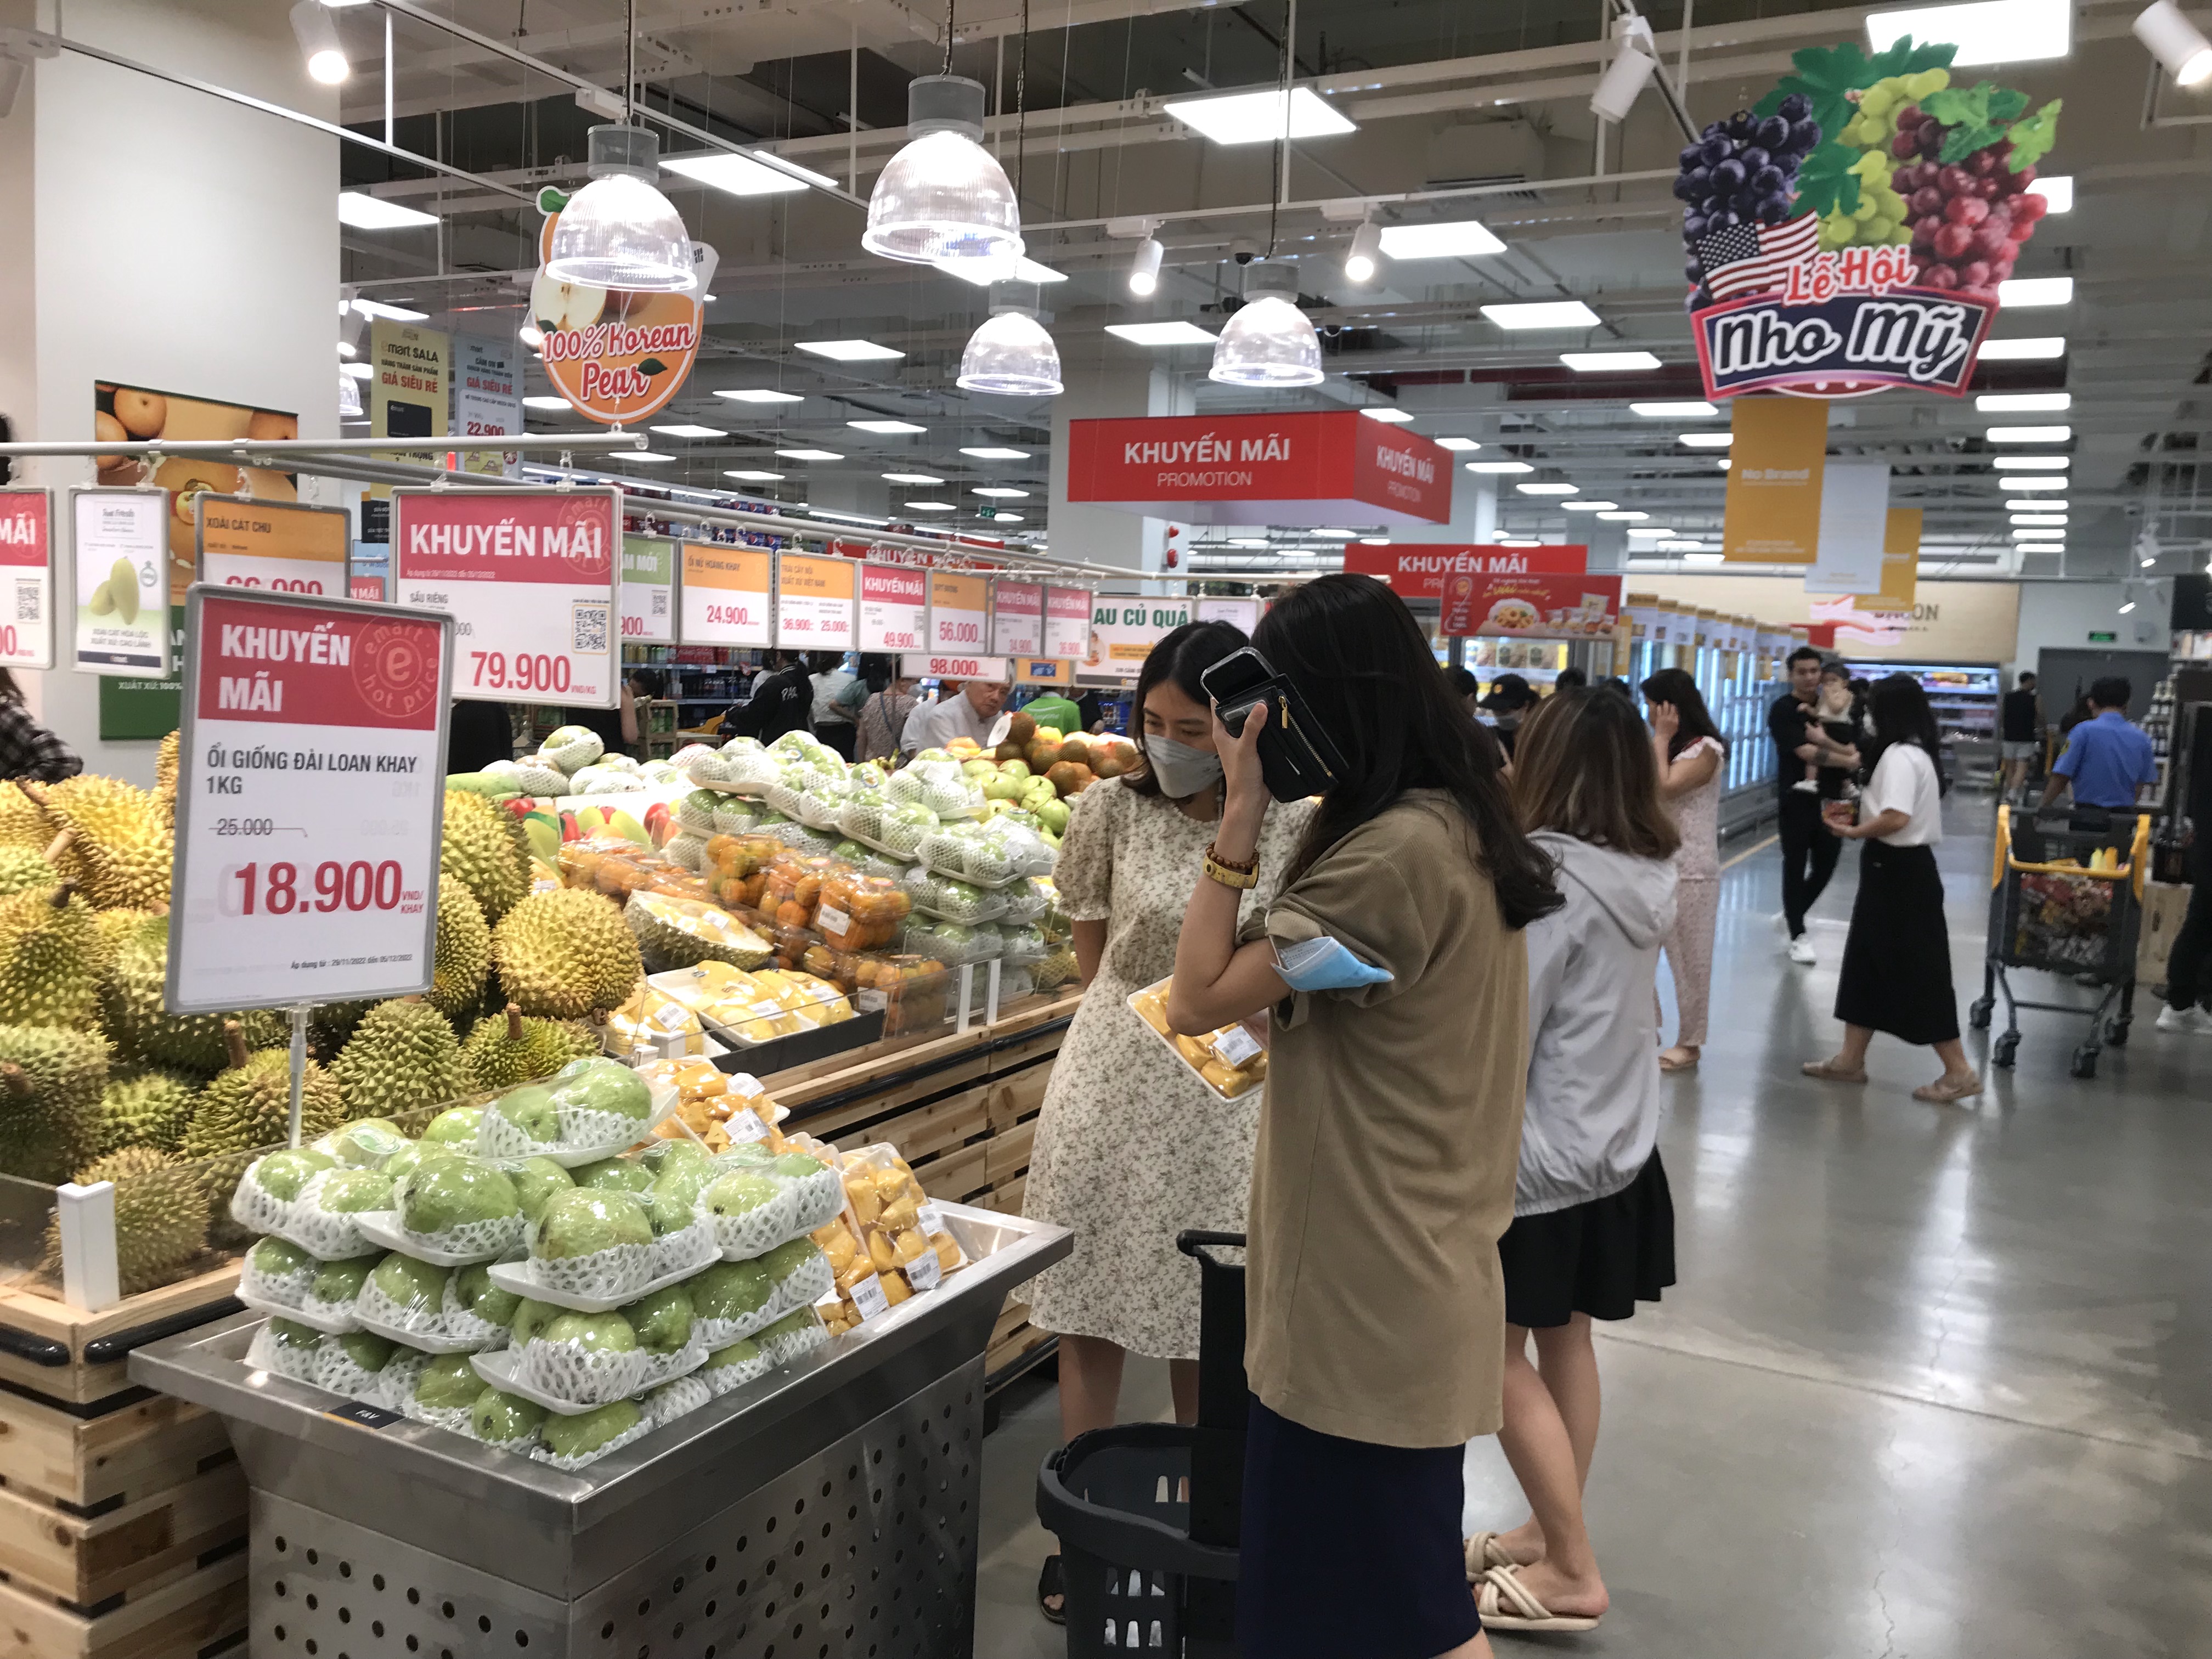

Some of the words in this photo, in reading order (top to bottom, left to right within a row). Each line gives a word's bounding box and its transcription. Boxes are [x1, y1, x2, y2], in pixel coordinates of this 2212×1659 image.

[1783, 253, 1838, 307] Lễ
[1839, 245, 1918, 295] Hội
[413, 347, 438, 362] SALA
[544, 323, 607, 362] 100%
[607, 323, 697, 356] Korean
[1714, 308, 1842, 374] Nho
[1846, 302, 1968, 381] Mỹ
[581, 360, 651, 400] Pear
[1125, 432, 1232, 464] KHUYẾN
[1240, 433, 1290, 461] MÃI
[1157, 471, 1252, 487] PROMOTION
[410, 517, 535, 556] KHUYẾN
[543, 521, 602, 558] MÃI
[1398, 551, 1482, 572] KHUYẾN
[1488, 553, 1527, 573] MÃI
[865, 577, 906, 594] KHUYẾN
[906, 579, 923, 596] MÃI
[622, 616, 644, 635] 900
[707, 605, 748, 625] 24.900
[1093, 608, 1117, 625] AU
[1123, 603, 1147, 626] CỦ
[1153, 603, 1188, 629] QUẢ
[221, 621, 351, 666] KHUYẾN
[940, 621, 978, 642] 56.000
[471, 651, 571, 692] 79.900
[930, 658, 978, 675] 98.000
[218, 670, 283, 712] MÃI
[207, 742, 226, 768] ỔI
[233, 744, 287, 769] GIỐNG
[294, 748, 323, 770] ĐÀI
[328, 754, 371, 771] LOAN
[376, 755, 417, 773] KHAY
[206, 776, 242, 794] 1KG
[217, 818, 273, 836] 25.000
[235, 860, 403, 916] 18.900
[400, 904, 424, 915] KHAY
